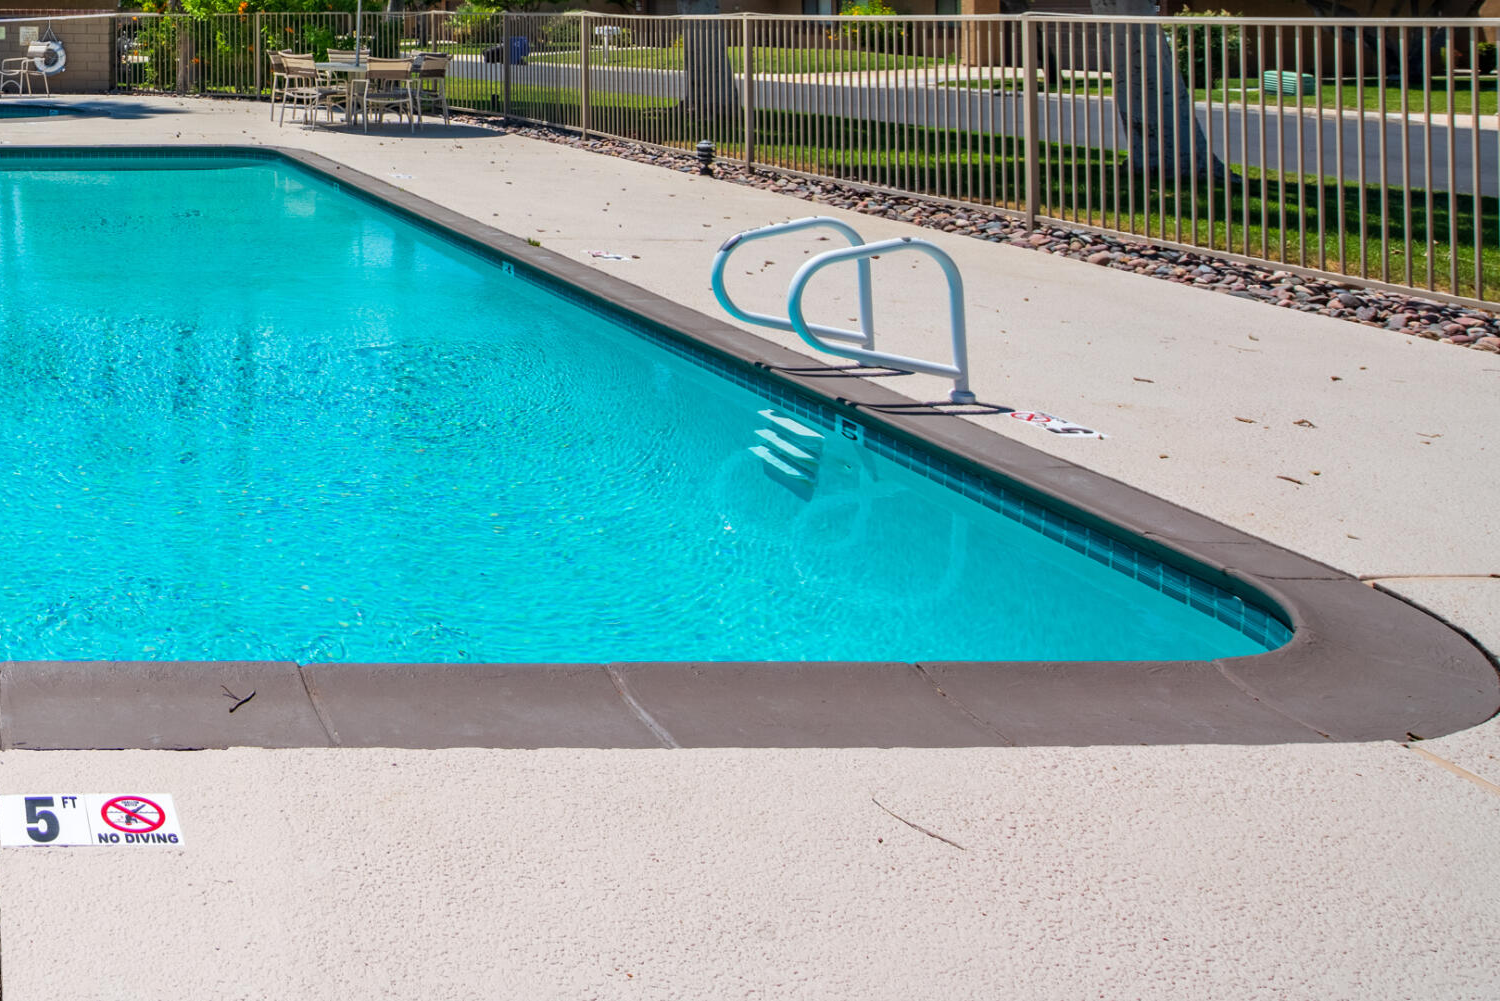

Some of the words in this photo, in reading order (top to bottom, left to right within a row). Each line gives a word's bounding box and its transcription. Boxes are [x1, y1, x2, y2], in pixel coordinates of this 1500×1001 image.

[841, 419, 858, 441] 5
[24, 796, 60, 843] 5
[61, 796, 78, 809] FT
[97, 832, 120, 844] NO
[125, 832, 180, 844] DIVING
